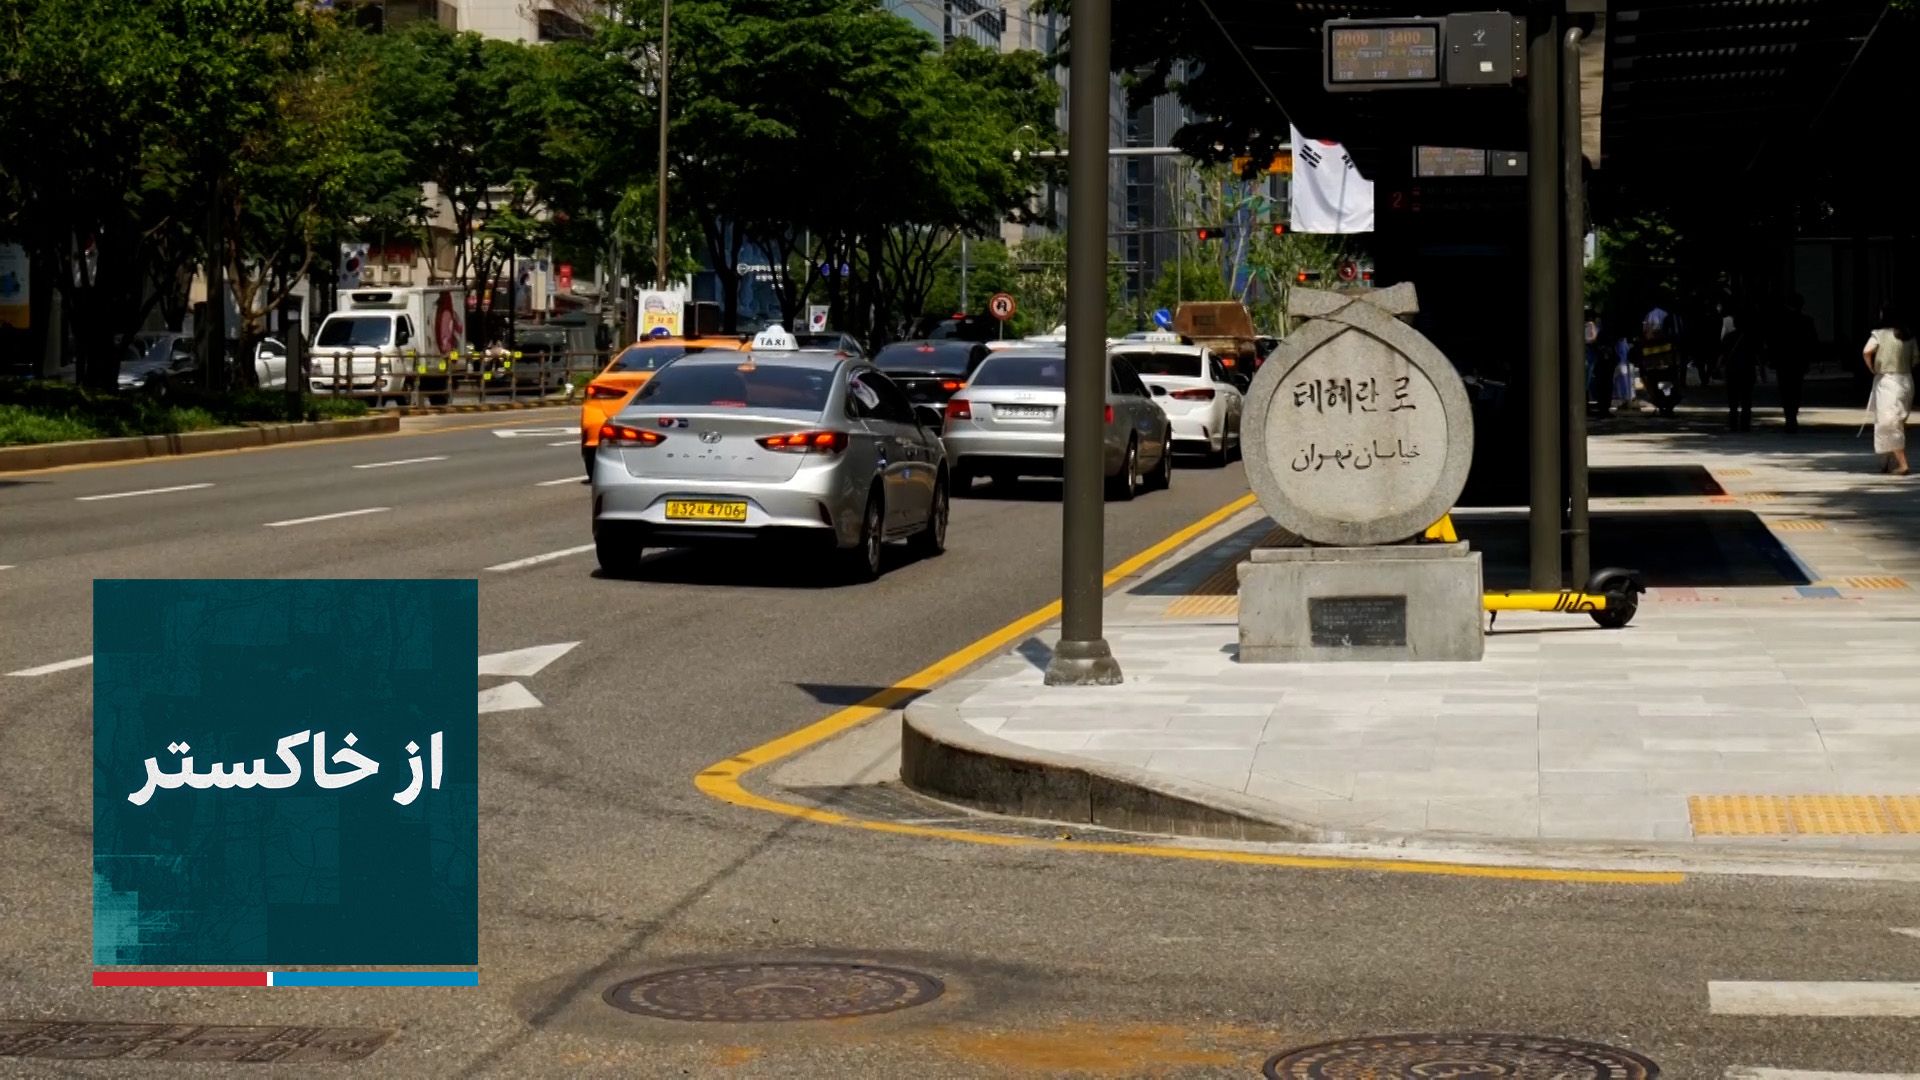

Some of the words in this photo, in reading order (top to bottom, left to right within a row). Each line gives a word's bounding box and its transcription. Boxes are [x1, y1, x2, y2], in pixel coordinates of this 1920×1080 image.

[760, 336, 786, 346] TAXI
[1293, 376, 1379, 415] 테헤란
[1388, 376, 1417, 413] 로
[1291, 443, 1354, 472] تهران
[707, 502, 741, 517] 4706
